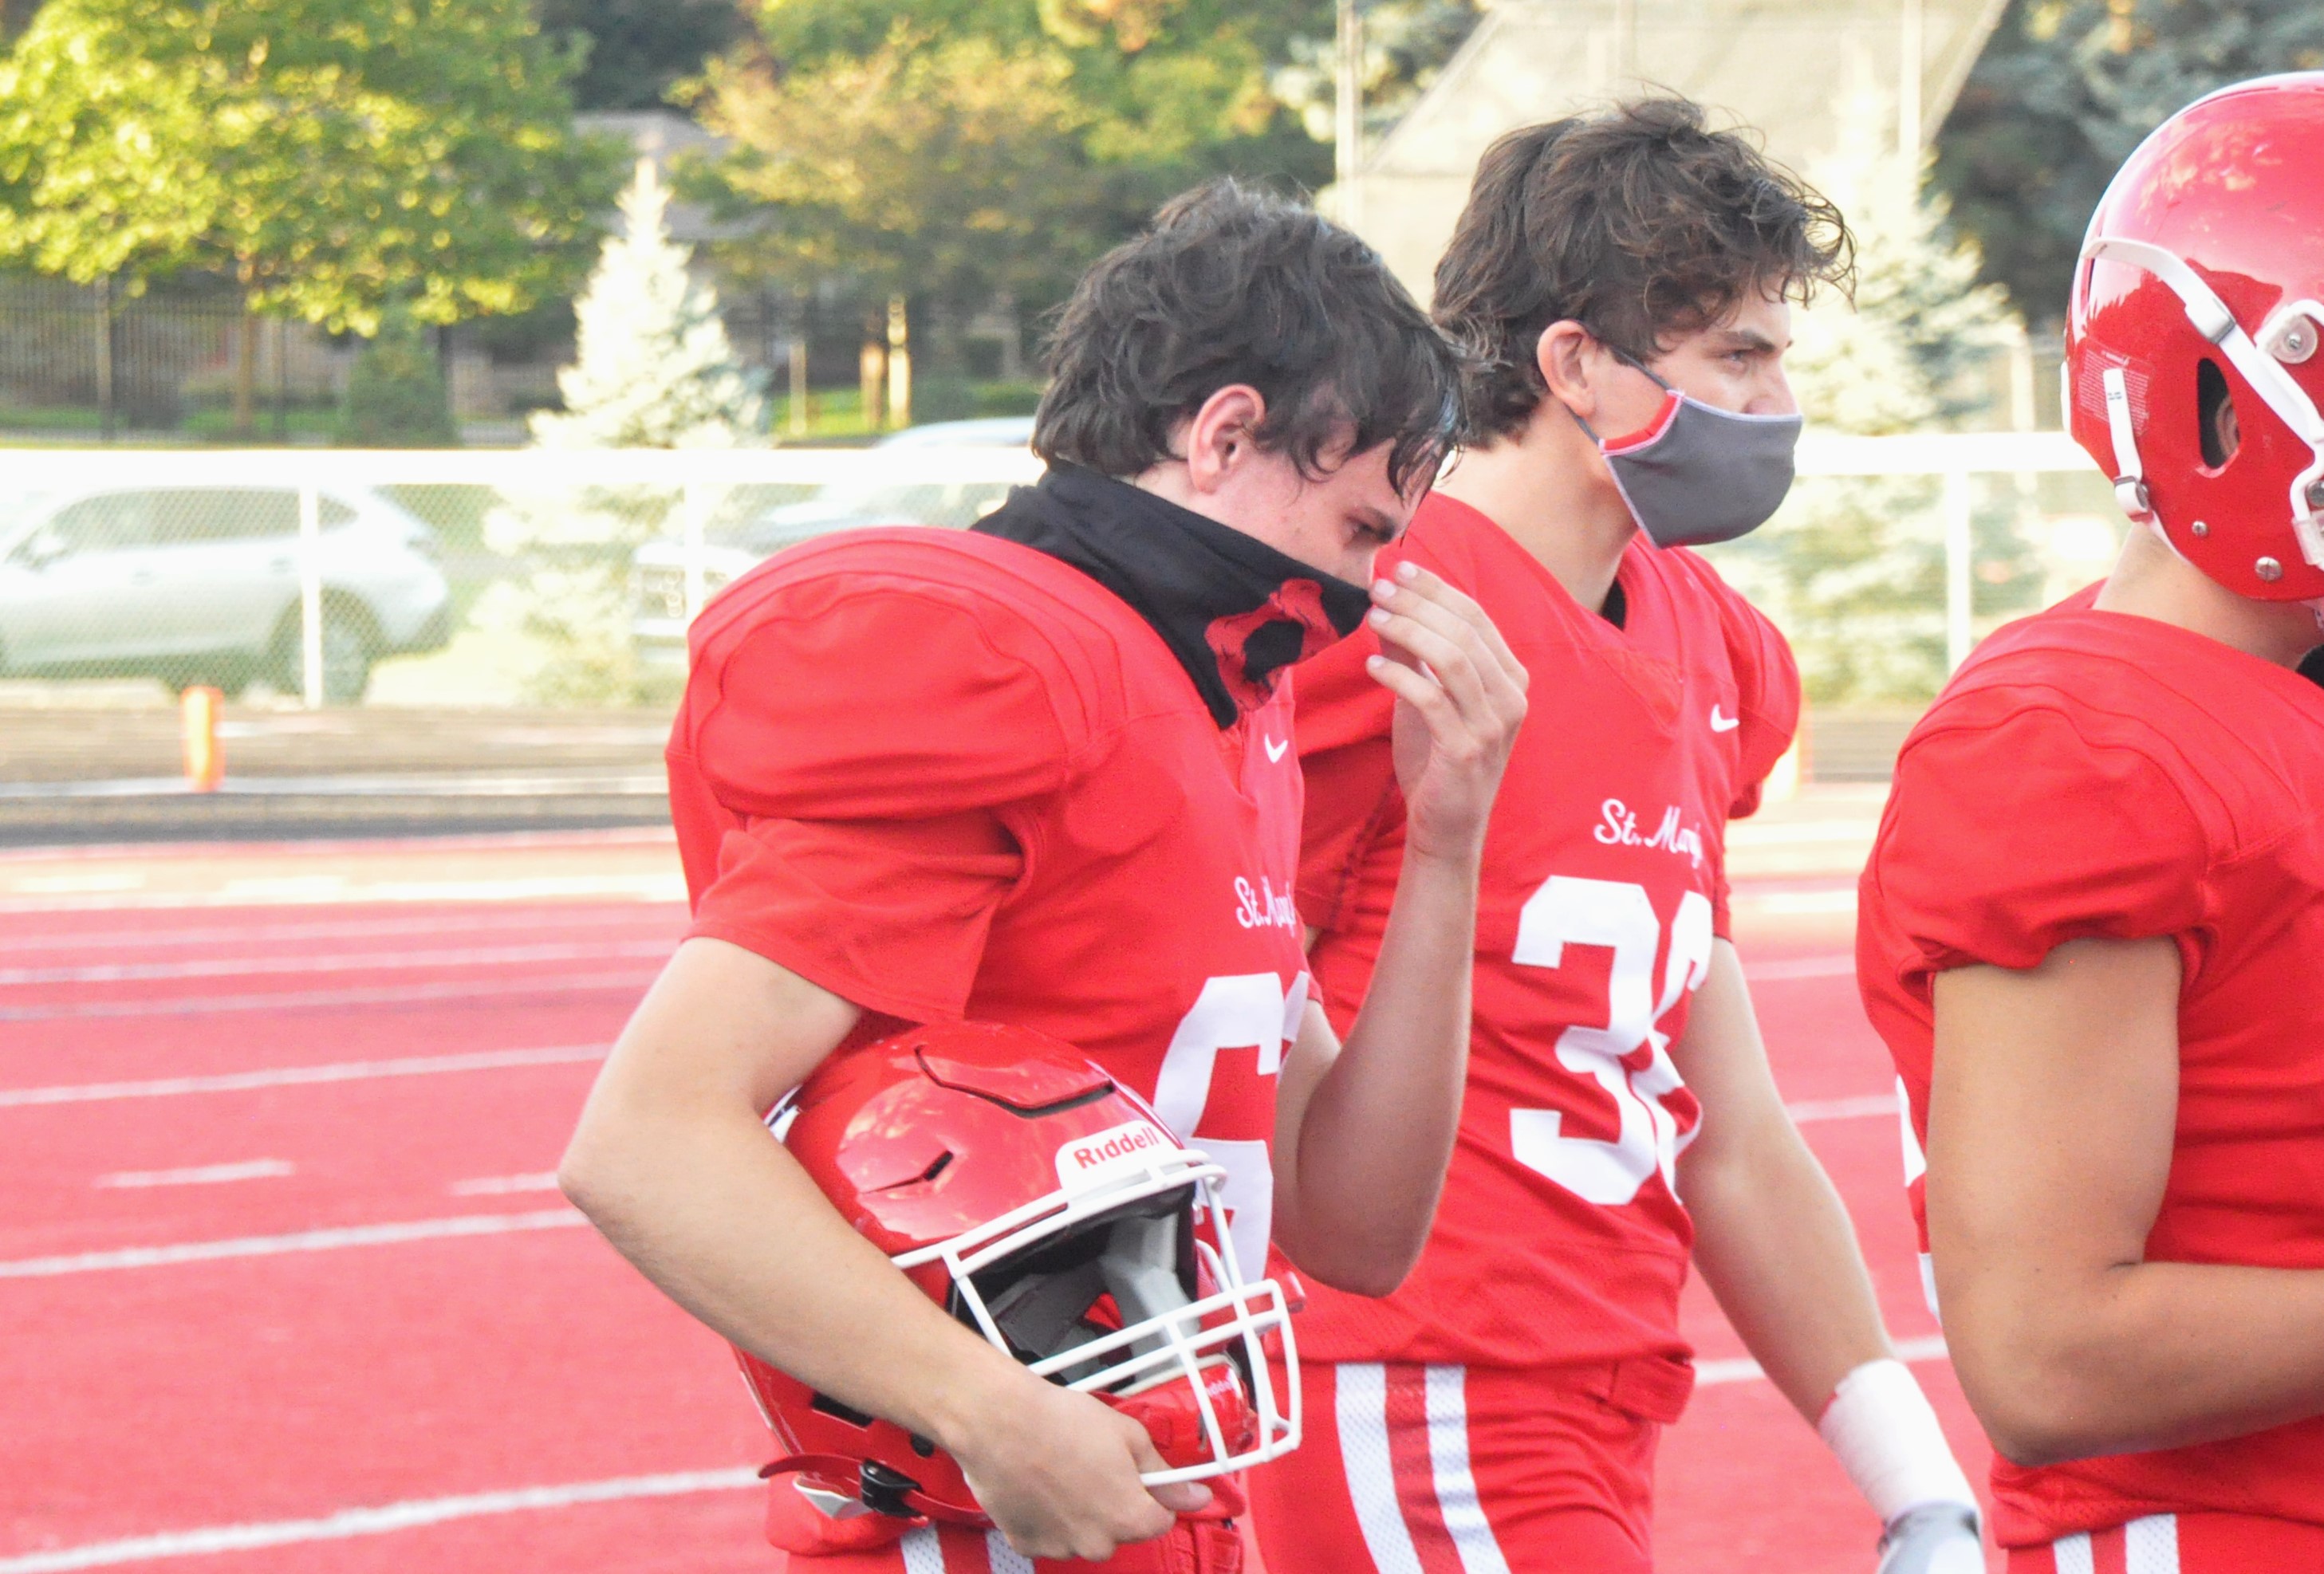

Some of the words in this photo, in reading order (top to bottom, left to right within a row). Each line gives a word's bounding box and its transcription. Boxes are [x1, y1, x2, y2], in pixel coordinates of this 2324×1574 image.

[1593, 798, 1642, 846] St.
[1234, 876, 1263, 929] St.
[1073, 1126, 1160, 1170] Riddell
[1153, 971, 1309, 1285] 6
